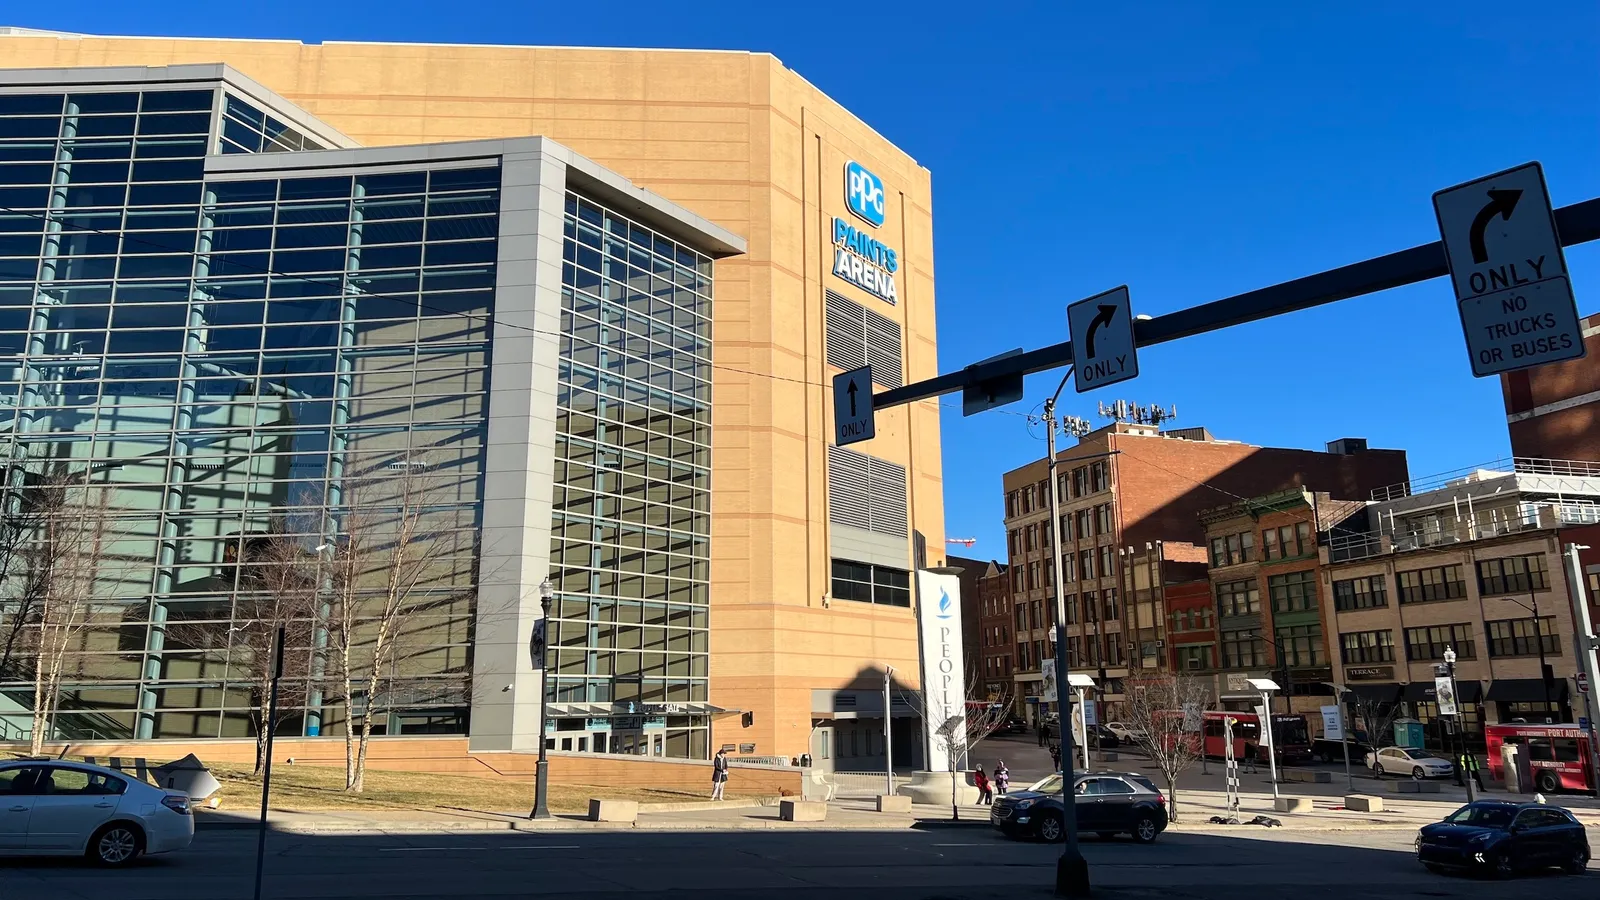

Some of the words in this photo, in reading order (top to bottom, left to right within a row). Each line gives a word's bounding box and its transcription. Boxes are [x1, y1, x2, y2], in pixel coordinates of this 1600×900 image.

[850, 170, 883, 215] PPG
[835, 217, 898, 273] PAINTS
[835, 249, 898, 304] ARENA
[1469, 255, 1546, 294] ONLY
[1502, 295, 1527, 314] NO
[1485, 312, 1556, 341] TRUCKS
[1479, 348, 1503, 365] OR
[1511, 333, 1573, 359] BUSES
[1083, 354, 1127, 382] ONLY
[841, 419, 868, 438] ONLY
[939, 627, 953, 719] PEOPLE
[1548, 729, 1564, 737] PORT
